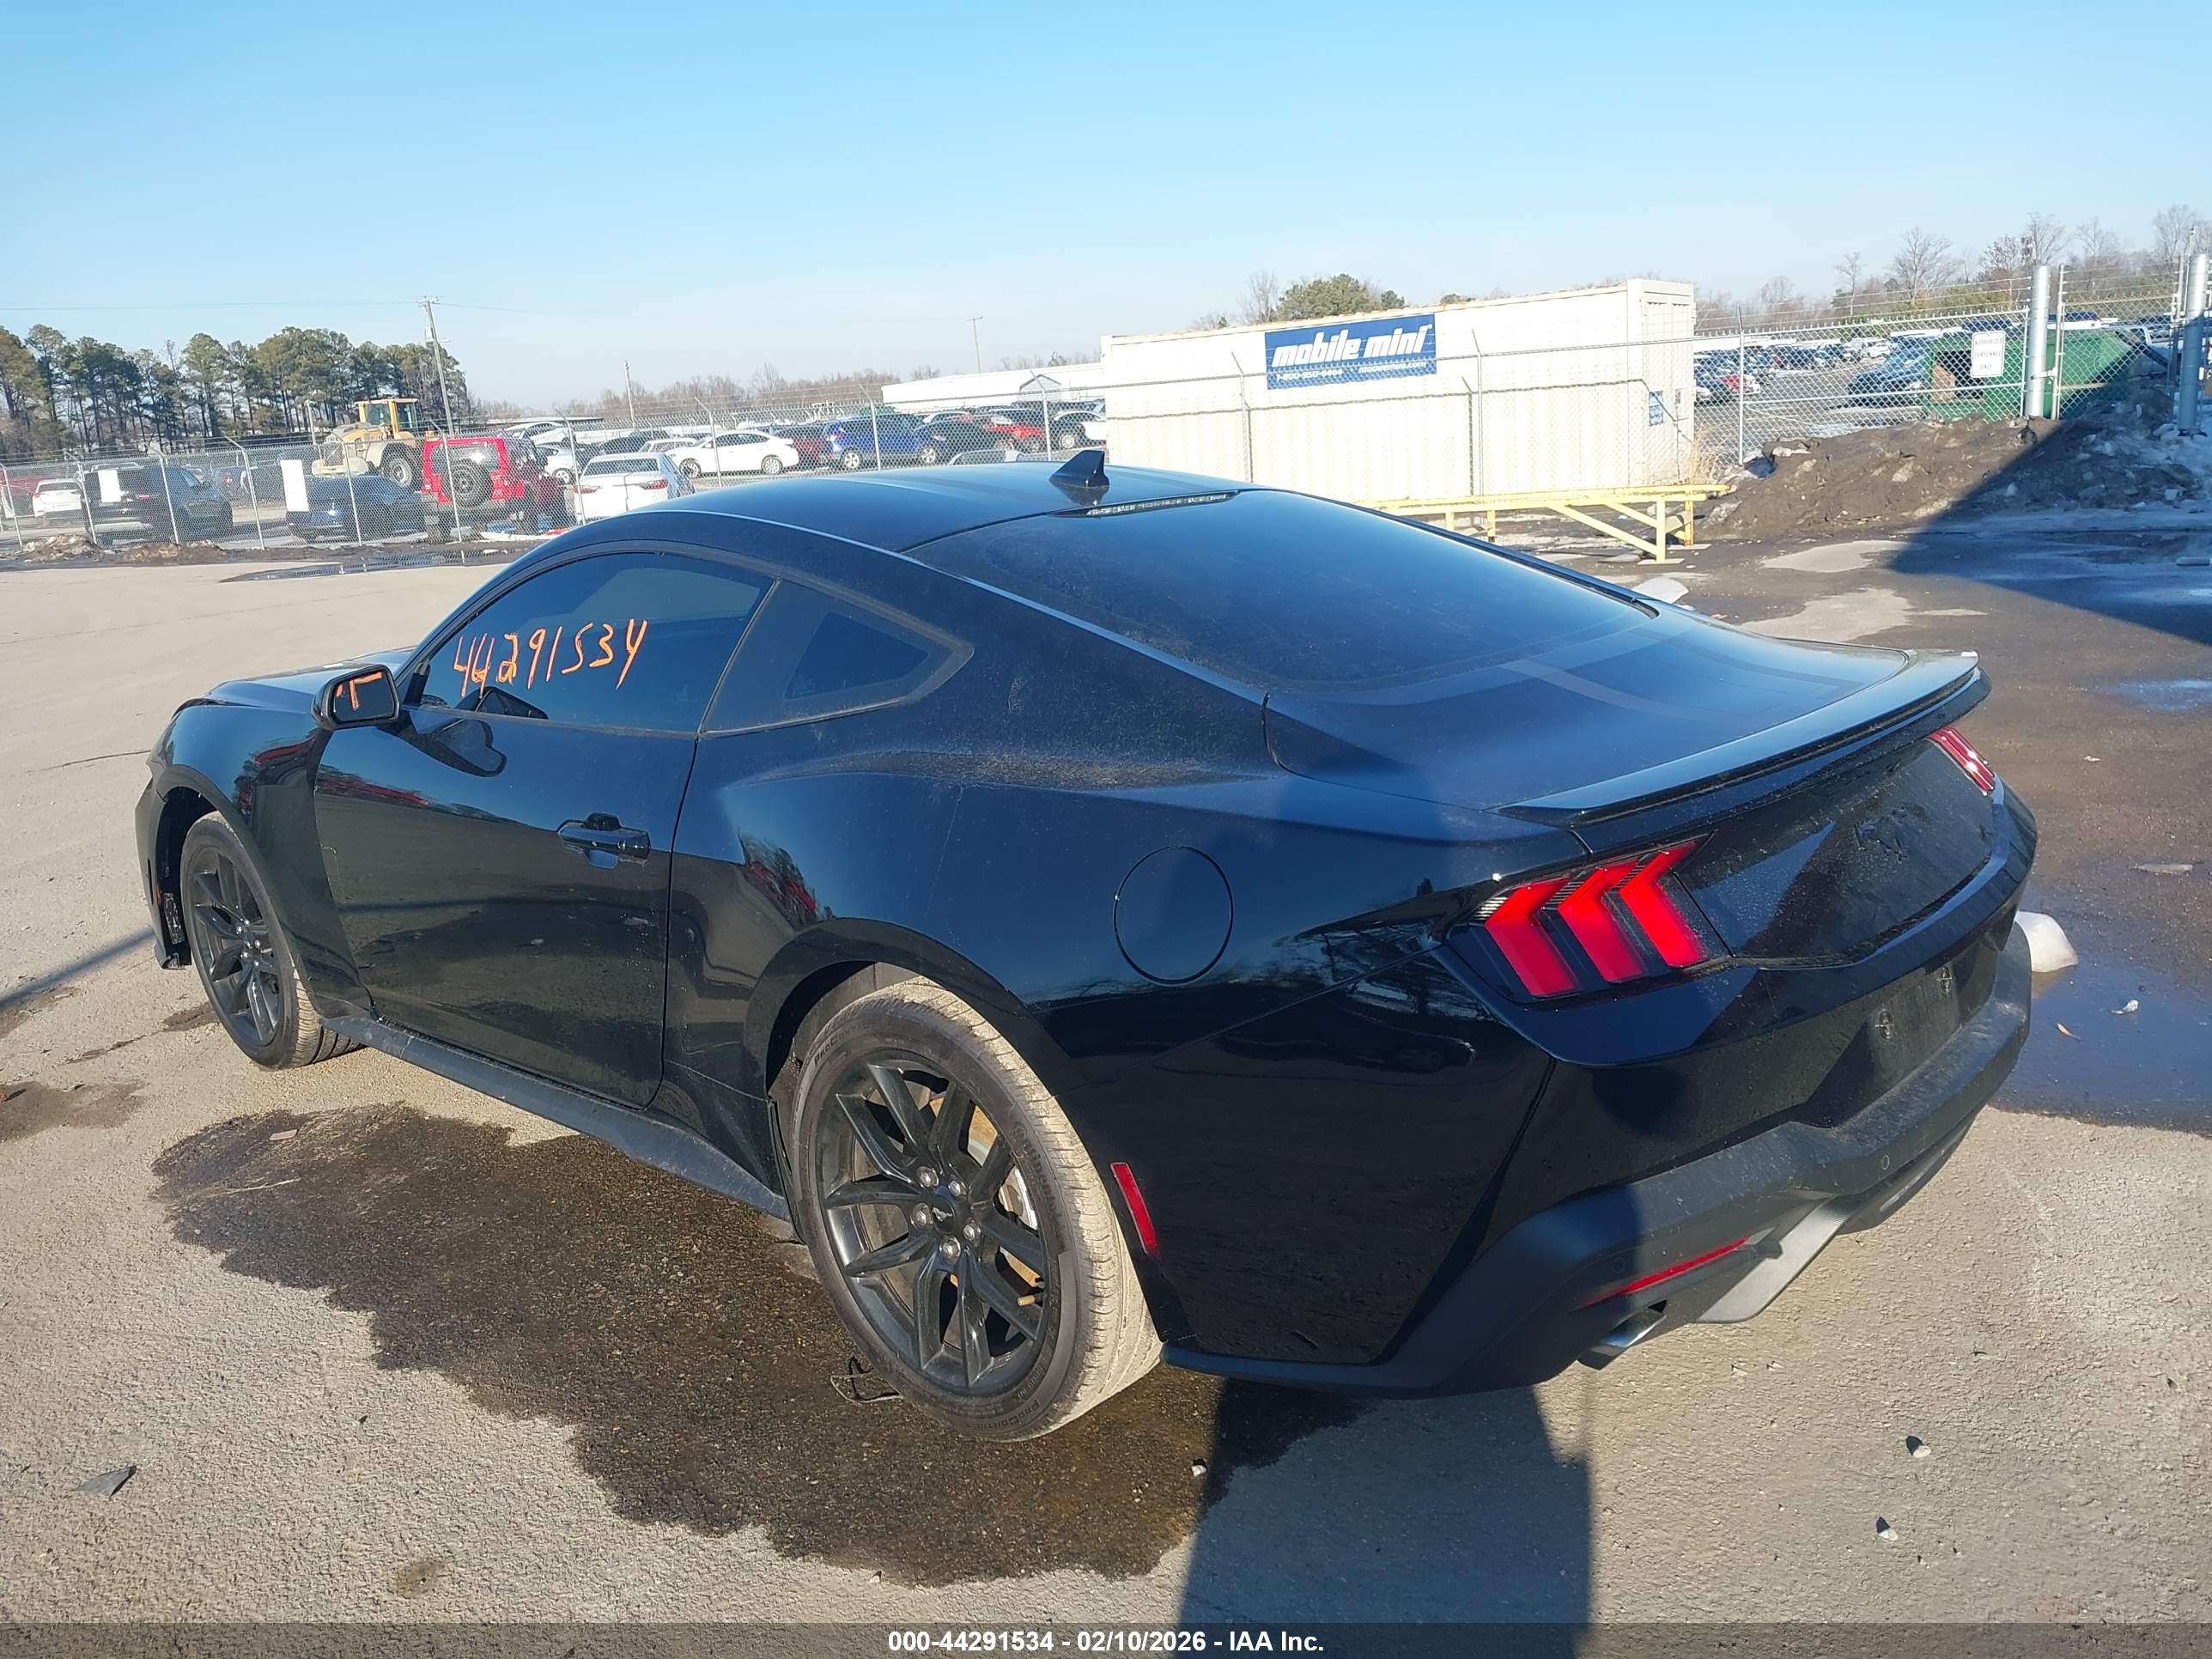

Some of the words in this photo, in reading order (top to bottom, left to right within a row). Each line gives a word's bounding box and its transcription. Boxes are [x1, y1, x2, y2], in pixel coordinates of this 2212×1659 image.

[1271, 329, 1362, 368] mobile
[1362, 325, 1429, 358] mini
[453, 618, 648, 698] 44291534
